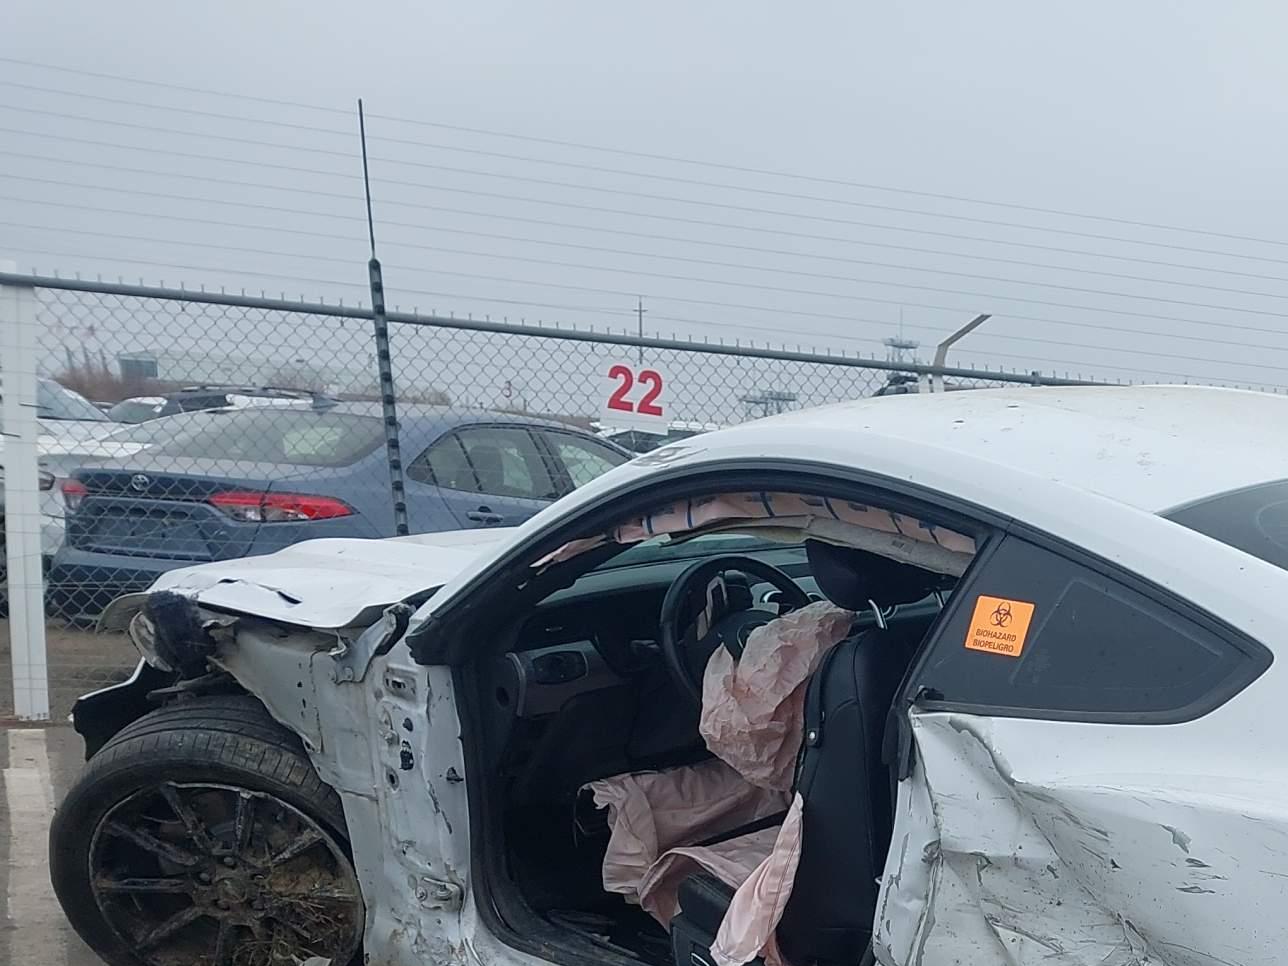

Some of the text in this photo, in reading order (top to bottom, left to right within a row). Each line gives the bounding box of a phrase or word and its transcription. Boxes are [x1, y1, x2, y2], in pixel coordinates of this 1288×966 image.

[607, 365, 662, 416] 22
[976, 629, 1017, 642] BIOHAZARD
[972, 639, 1014, 653] BIOPELIGRO
